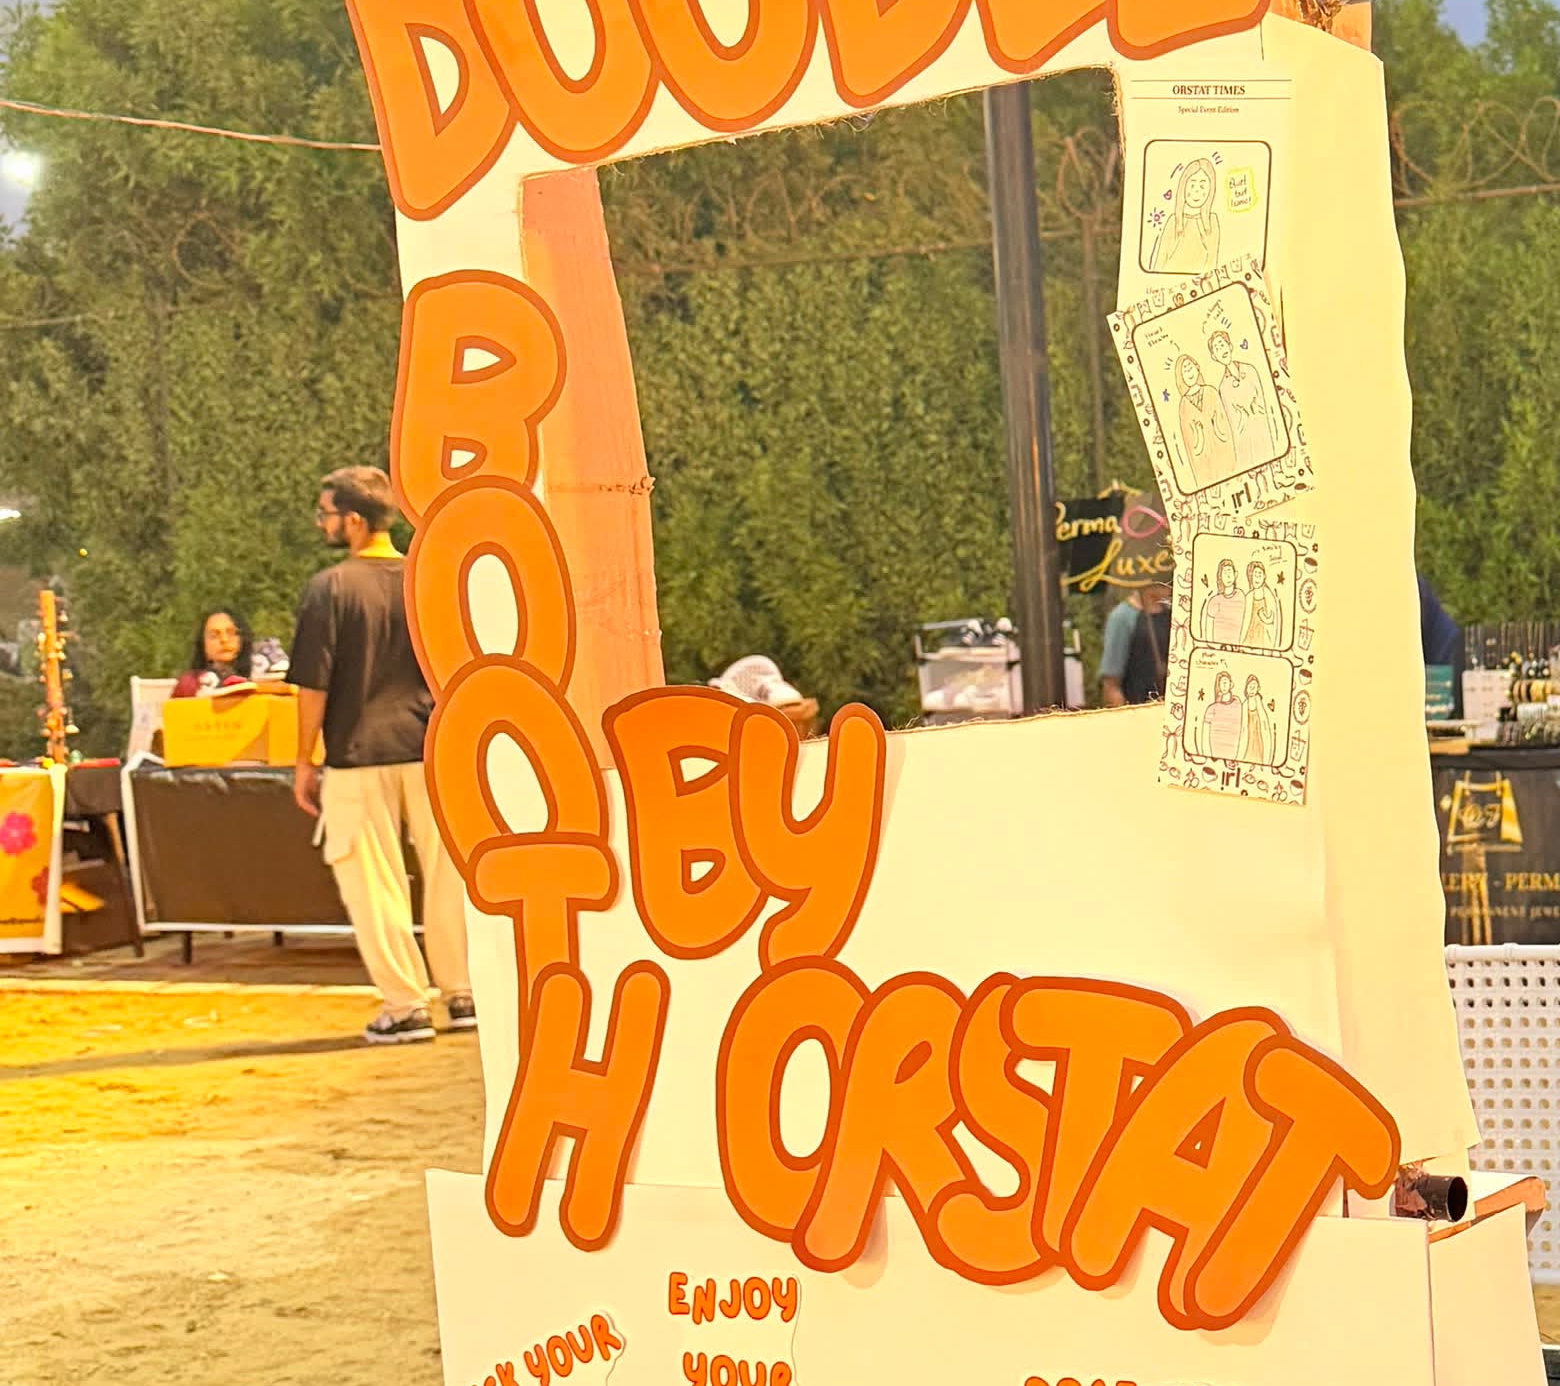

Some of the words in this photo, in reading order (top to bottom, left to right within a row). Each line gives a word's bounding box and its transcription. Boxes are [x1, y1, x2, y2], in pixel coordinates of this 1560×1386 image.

[1172, 84, 1212, 96] ORSTAT
[1213, 84, 1246, 96] TIMES
[1218, 105, 1240, 113] Edition
[1060, 537, 1176, 593] Luxe
[391, 269, 670, 1250] BOOTH
[603, 686, 886, 978] BY
[715, 956, 1400, 1331] ORSTAT
[668, 1272, 798, 1325] ENJOY
